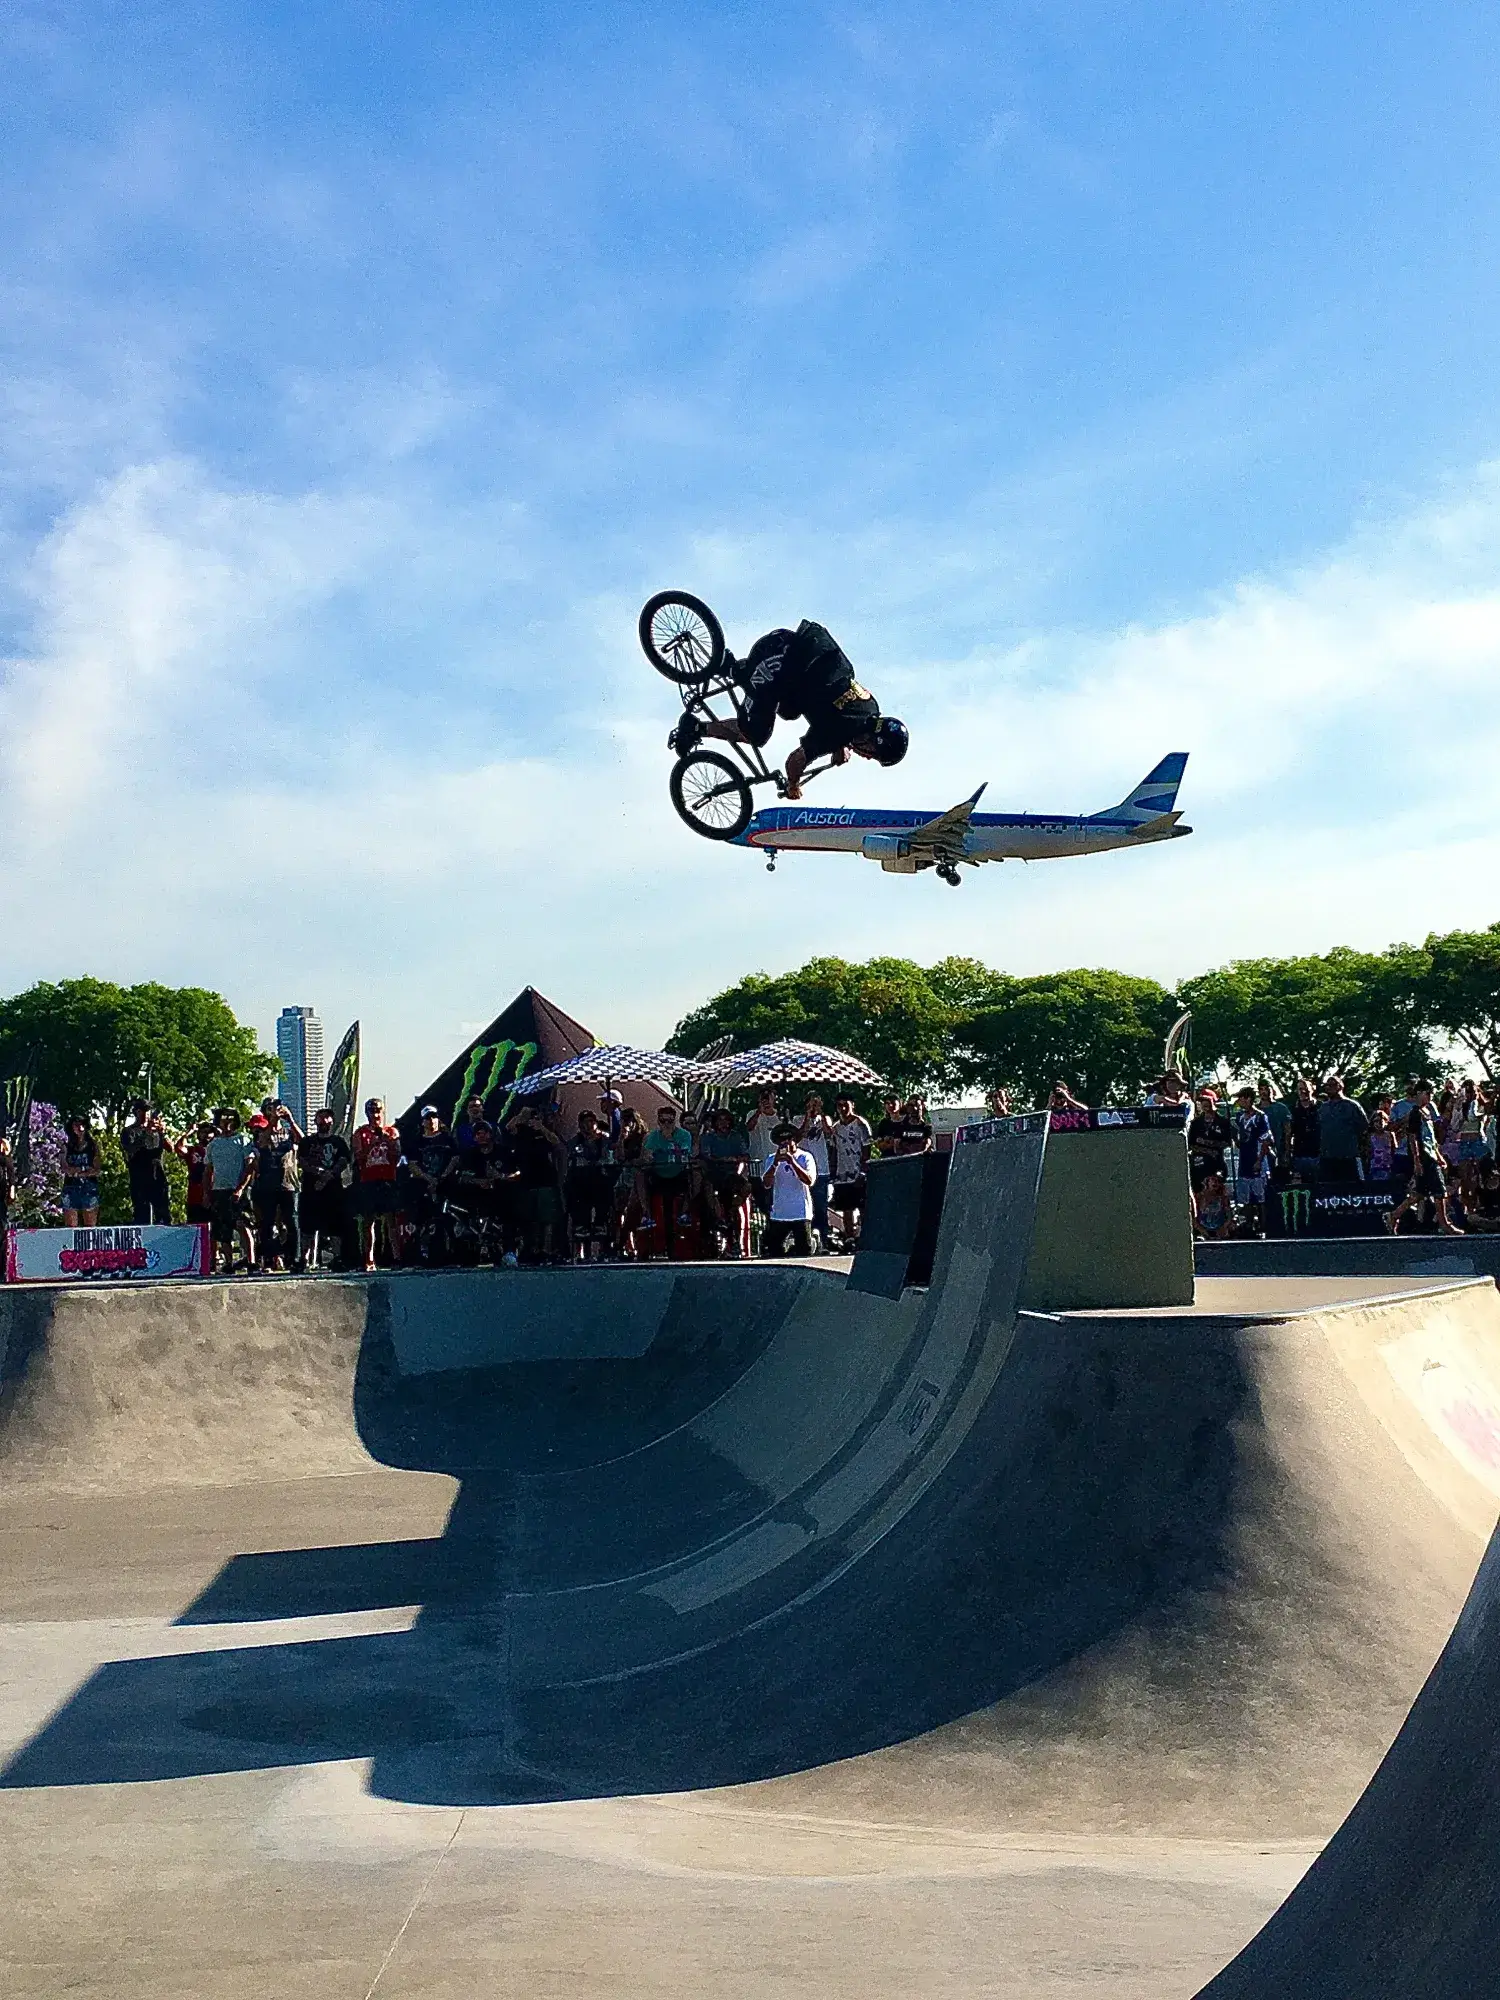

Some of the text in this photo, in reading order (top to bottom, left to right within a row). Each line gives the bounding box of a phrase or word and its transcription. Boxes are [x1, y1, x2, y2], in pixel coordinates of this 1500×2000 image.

[795, 811, 856, 824] Austral
[1315, 1195, 1394, 1208] MONSTER
[74, 1228, 142, 1250] BUENOS AIRES
